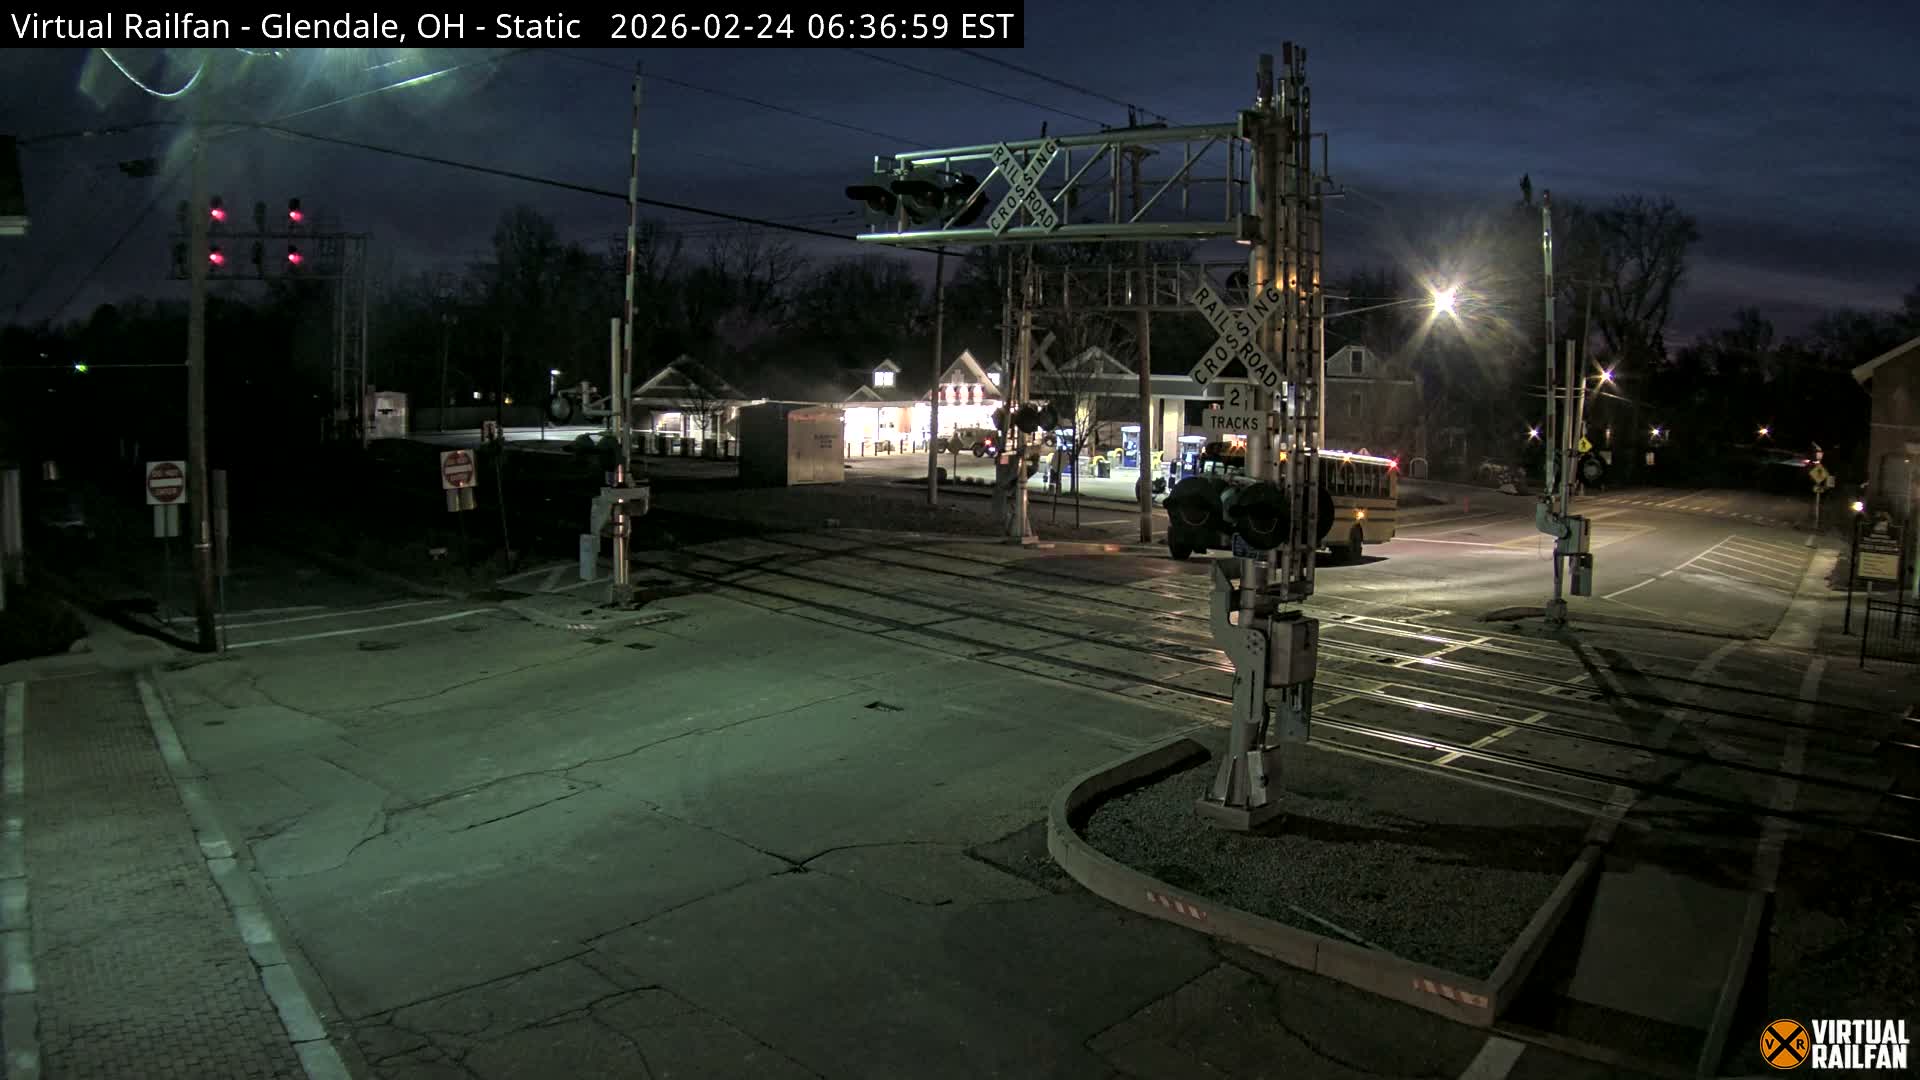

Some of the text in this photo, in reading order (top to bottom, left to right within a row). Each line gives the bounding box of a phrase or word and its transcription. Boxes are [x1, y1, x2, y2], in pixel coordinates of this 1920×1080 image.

[991, 141, 1056, 230] CROSSING
[1194, 287, 1280, 385] CROSSING
[1211, 415, 1259, 430] TRACKS
[1230, 388, 1240, 406] 2
